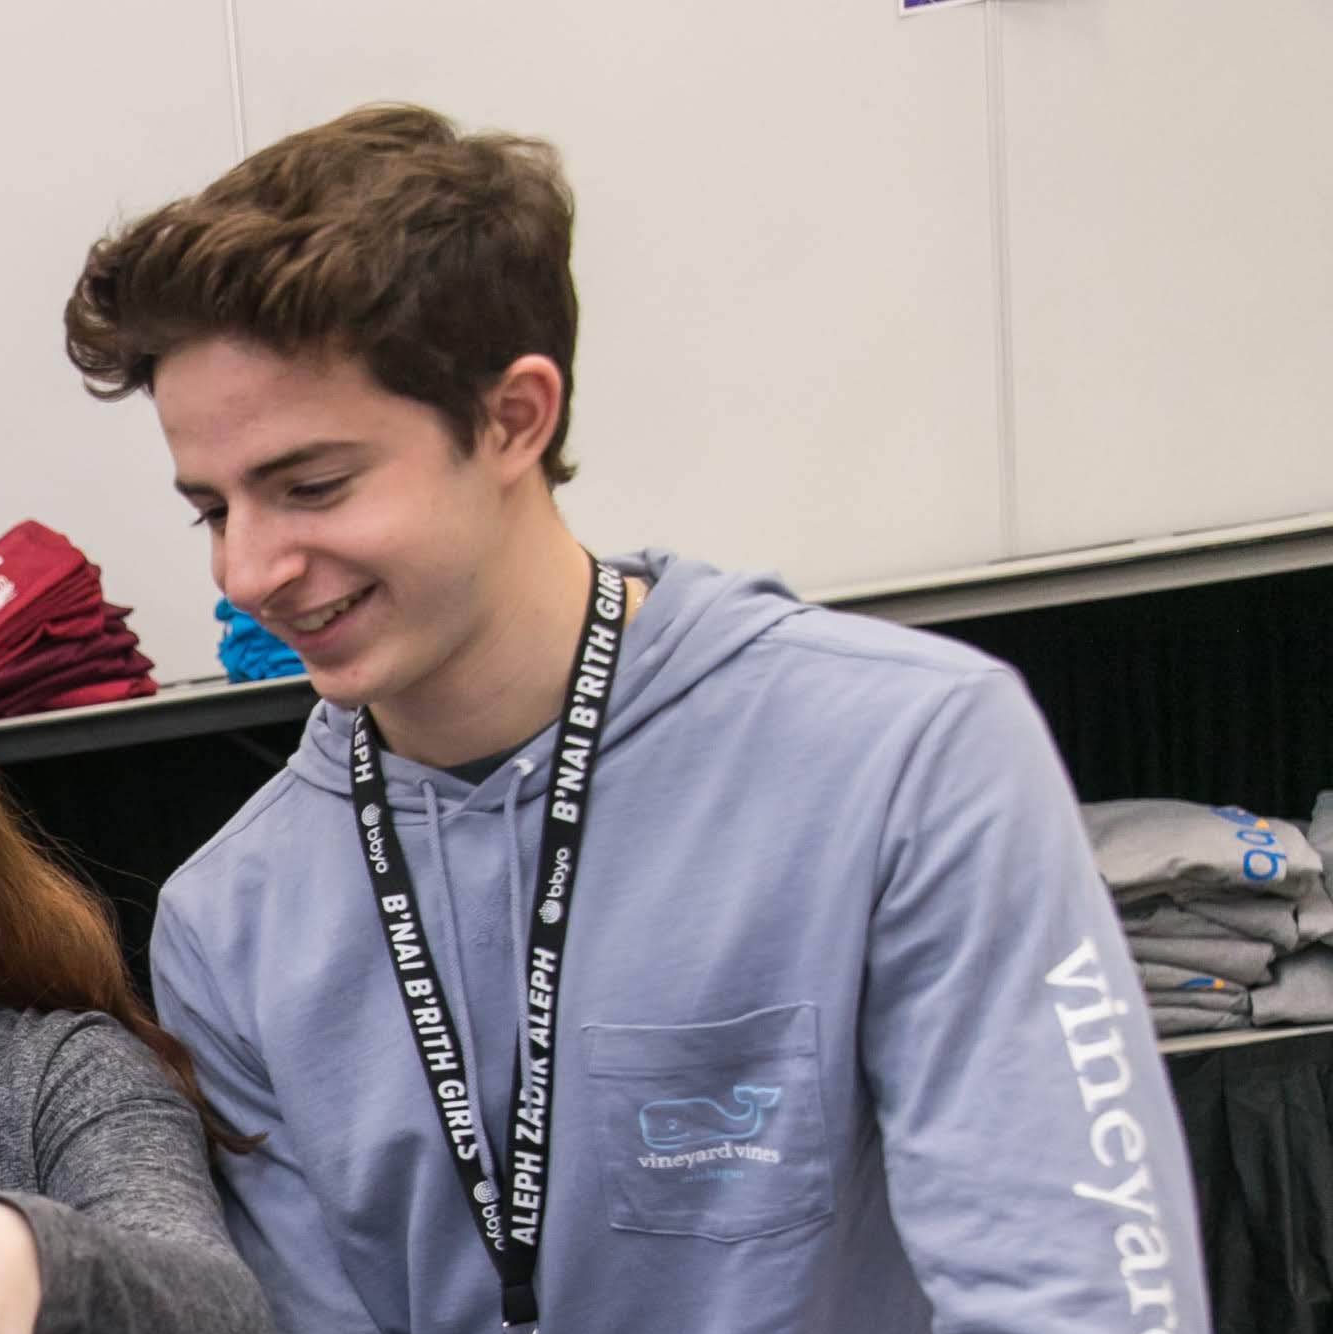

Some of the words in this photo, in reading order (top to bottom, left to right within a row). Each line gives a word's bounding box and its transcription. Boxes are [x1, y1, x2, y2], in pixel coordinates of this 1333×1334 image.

[569, 627, 617, 729] B'RITH
[353, 715, 374, 783] LEPH
[551, 735, 590, 823] B'NAI
[546, 847, 571, 898] bbyo
[382, 894, 424, 971] B'NAI
[404, 979, 459, 1072] B'RITH
[437, 1078, 477, 1161] GIRLS
[638, 1142, 732, 1170] vineyard
[734, 1142, 781, 1165] vines
[510, 1158, 543, 1247] ALEPH
